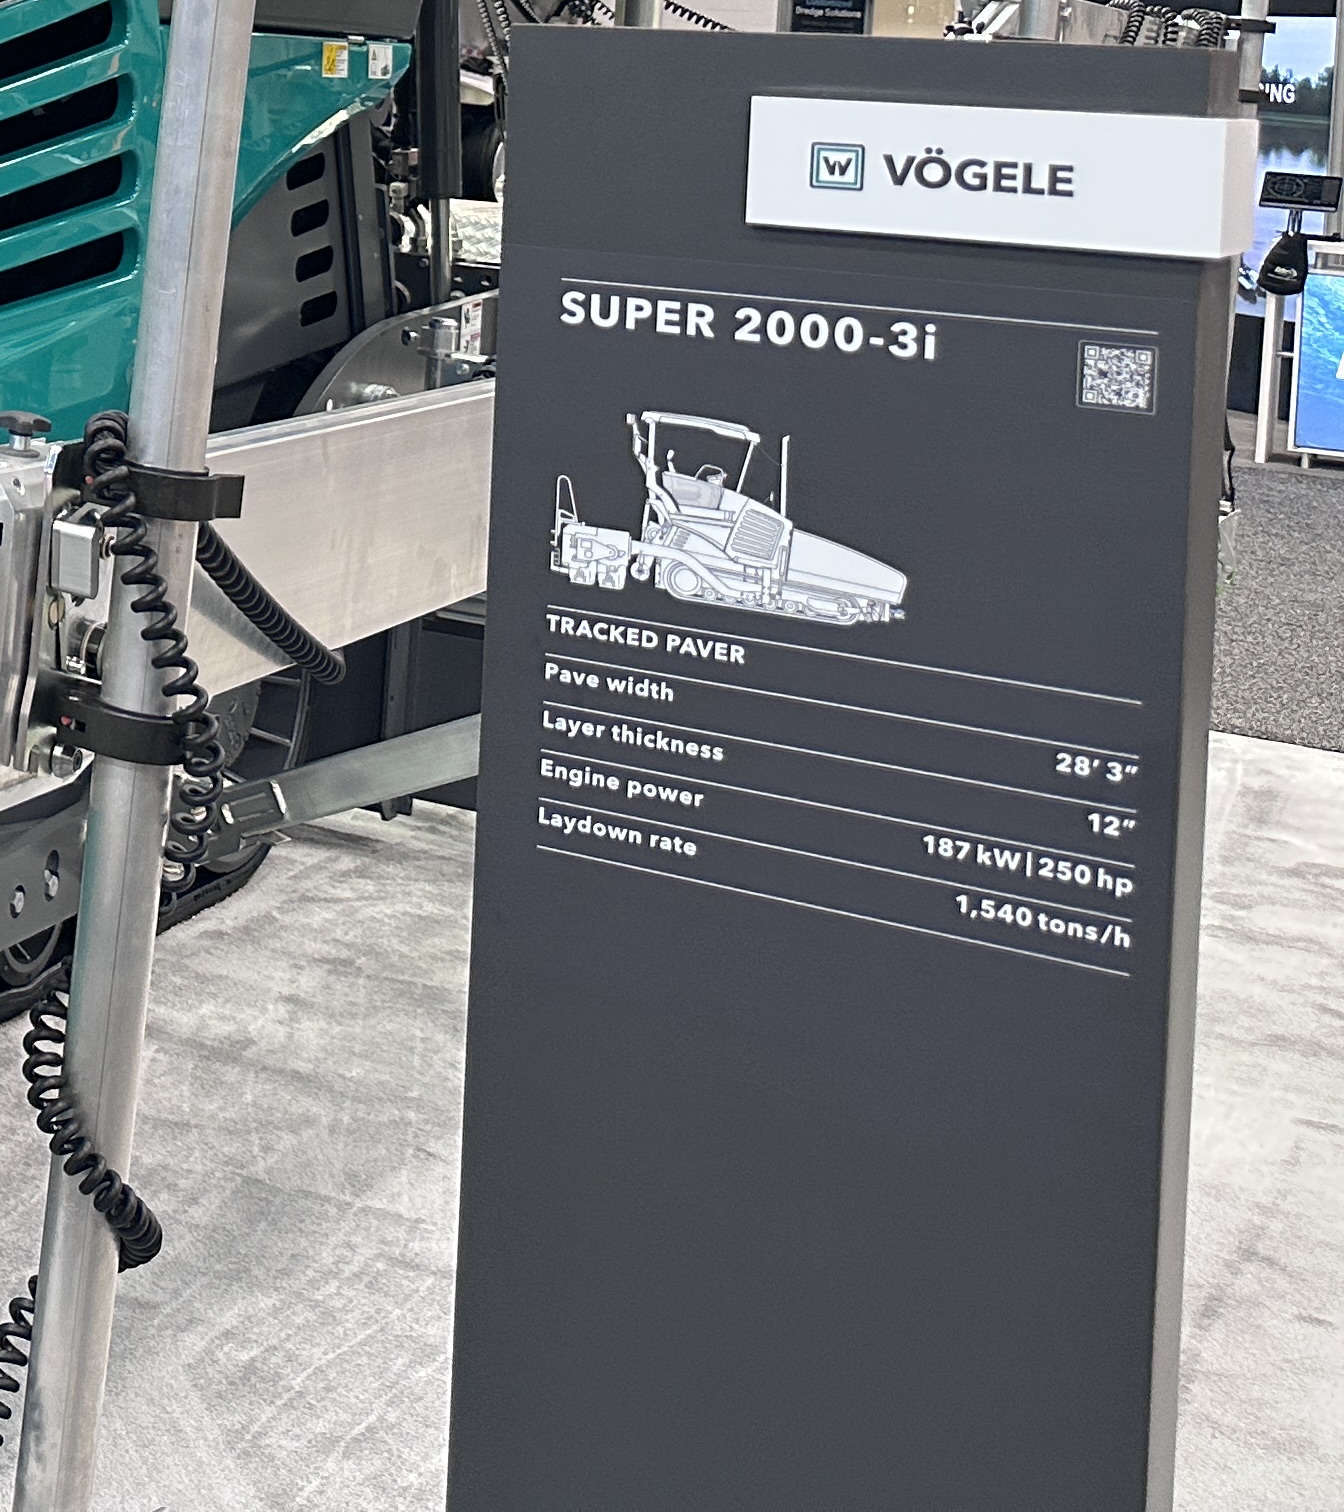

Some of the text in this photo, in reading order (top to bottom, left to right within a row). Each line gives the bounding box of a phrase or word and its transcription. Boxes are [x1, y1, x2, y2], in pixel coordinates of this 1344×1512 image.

[882, 146, 1074, 198] VÖGELE
[560, 291, 937, 361] SUPER 2000-3i
[546, 614, 746, 664] TRACKED PAVER
[544, 662, 674, 702] Pave width
[542, 710, 725, 761] Layer thickness
[540, 758, 705, 807] Engine power
[538, 806, 698, 856] Laydown rate
[922, 834, 971, 860] 187
[1097, 867, 1134, 898] hp
[955, 894, 1131, 949] 1,540 tons/h
